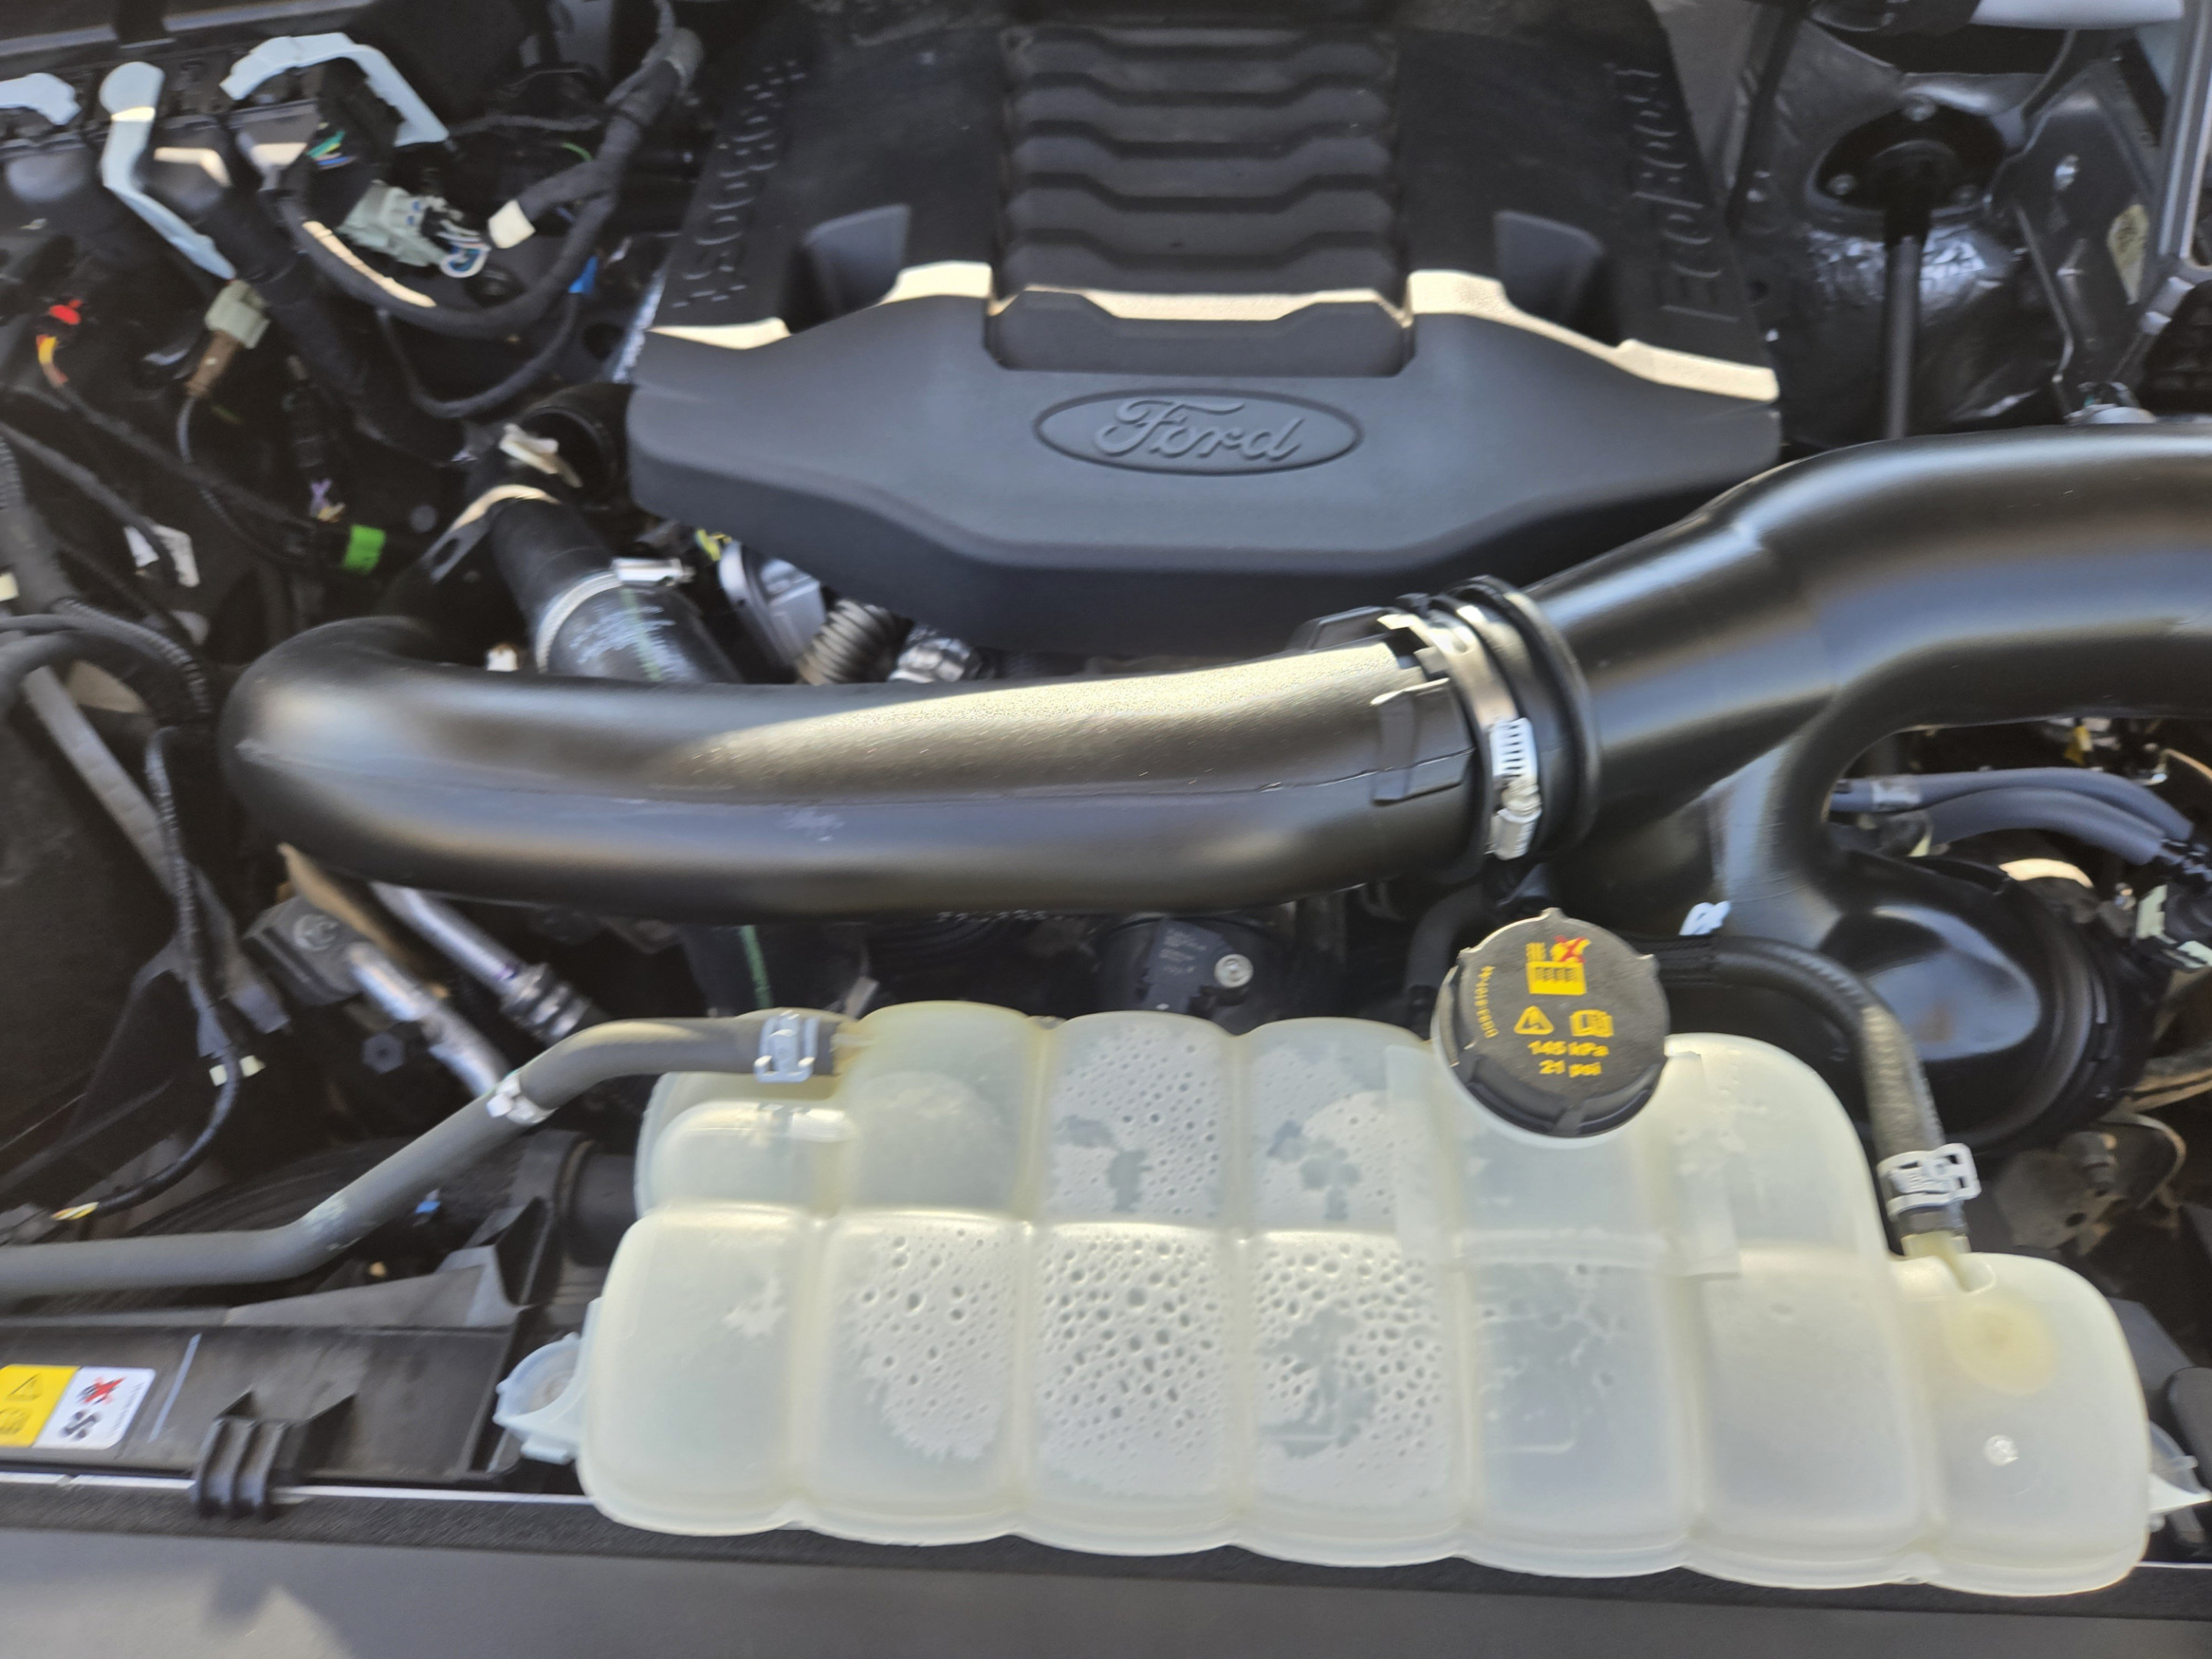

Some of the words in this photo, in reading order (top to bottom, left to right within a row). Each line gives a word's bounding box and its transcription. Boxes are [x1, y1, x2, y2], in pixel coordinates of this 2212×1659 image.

[1091, 398, 1304, 463] Ford
[1528, 1040, 1567, 1055] 145
[1568, 1041, 1609, 1058] kPa
[1538, 1059, 1566, 1075] 21
[1568, 1061, 1601, 1078] psi
